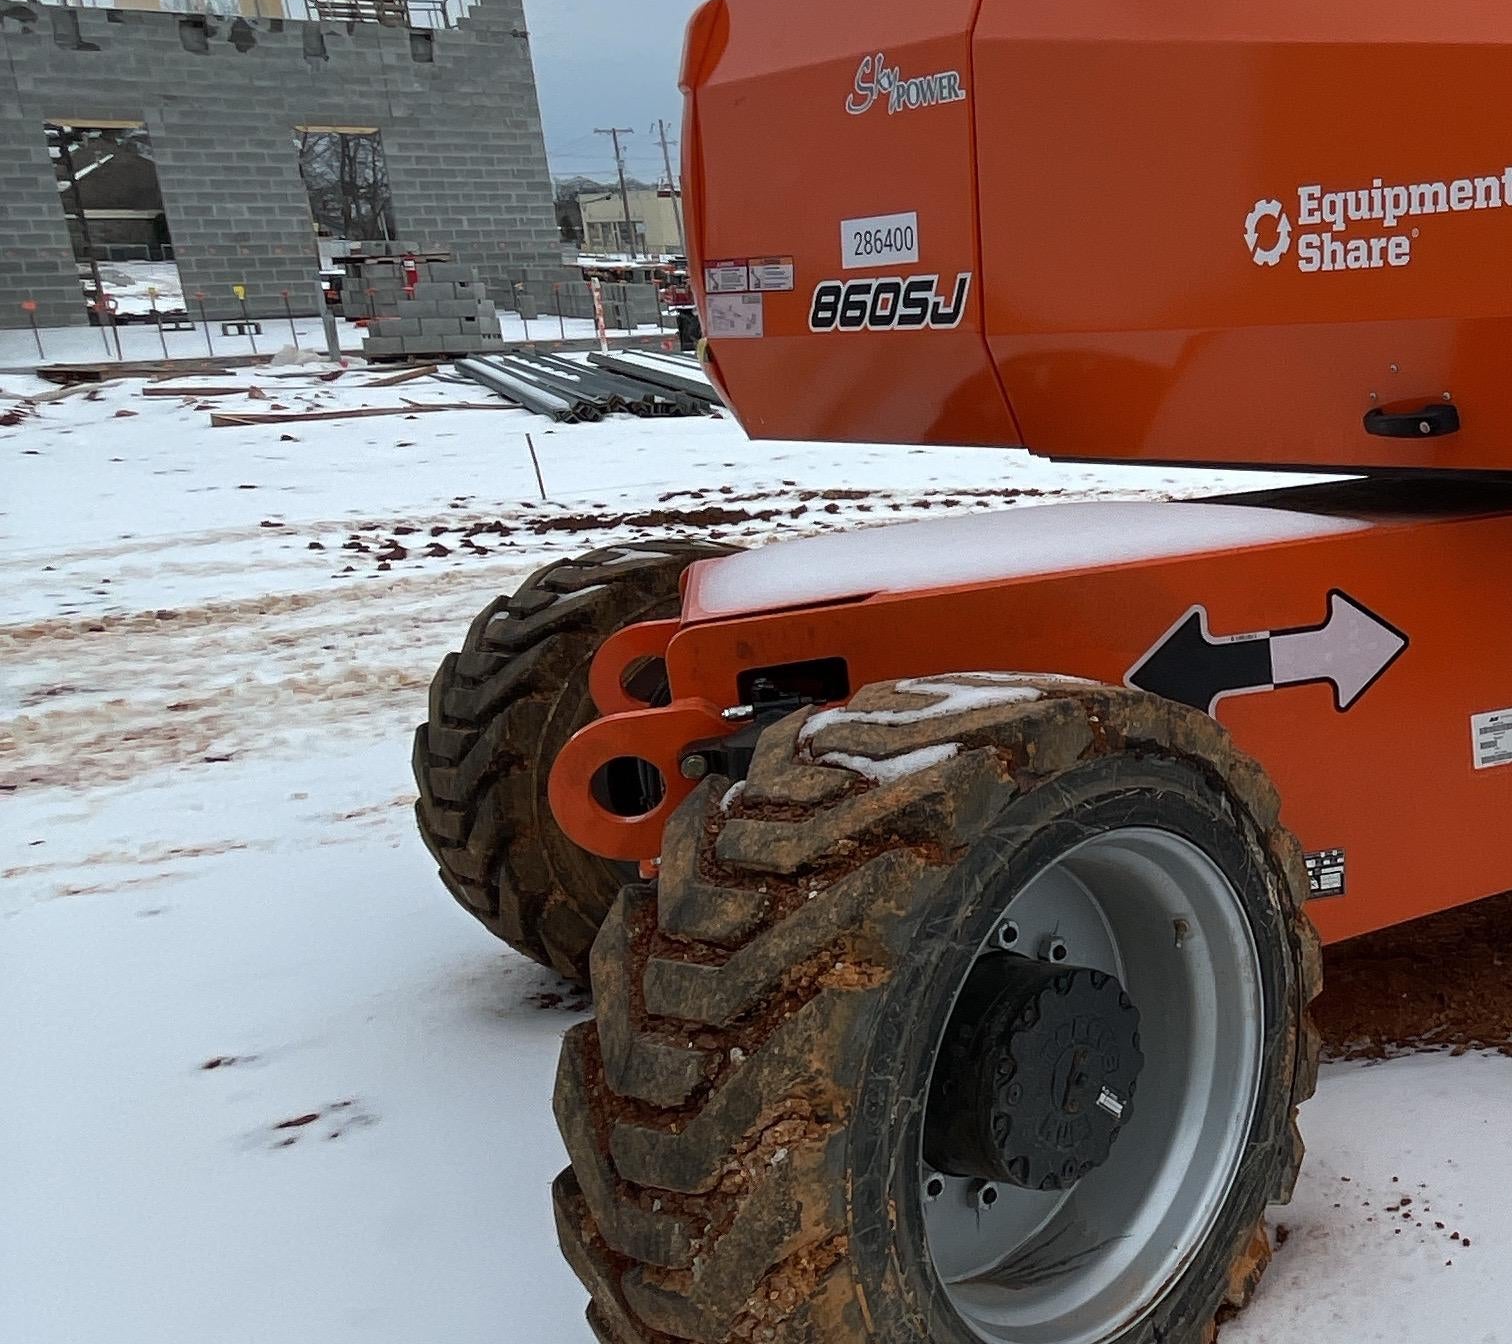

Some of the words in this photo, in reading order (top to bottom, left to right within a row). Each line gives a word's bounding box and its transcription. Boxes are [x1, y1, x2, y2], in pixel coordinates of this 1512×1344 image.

[853, 225, 915, 257] 286400
[1298, 233, 1411, 273] Share
[808, 272, 972, 333] 860SJ
